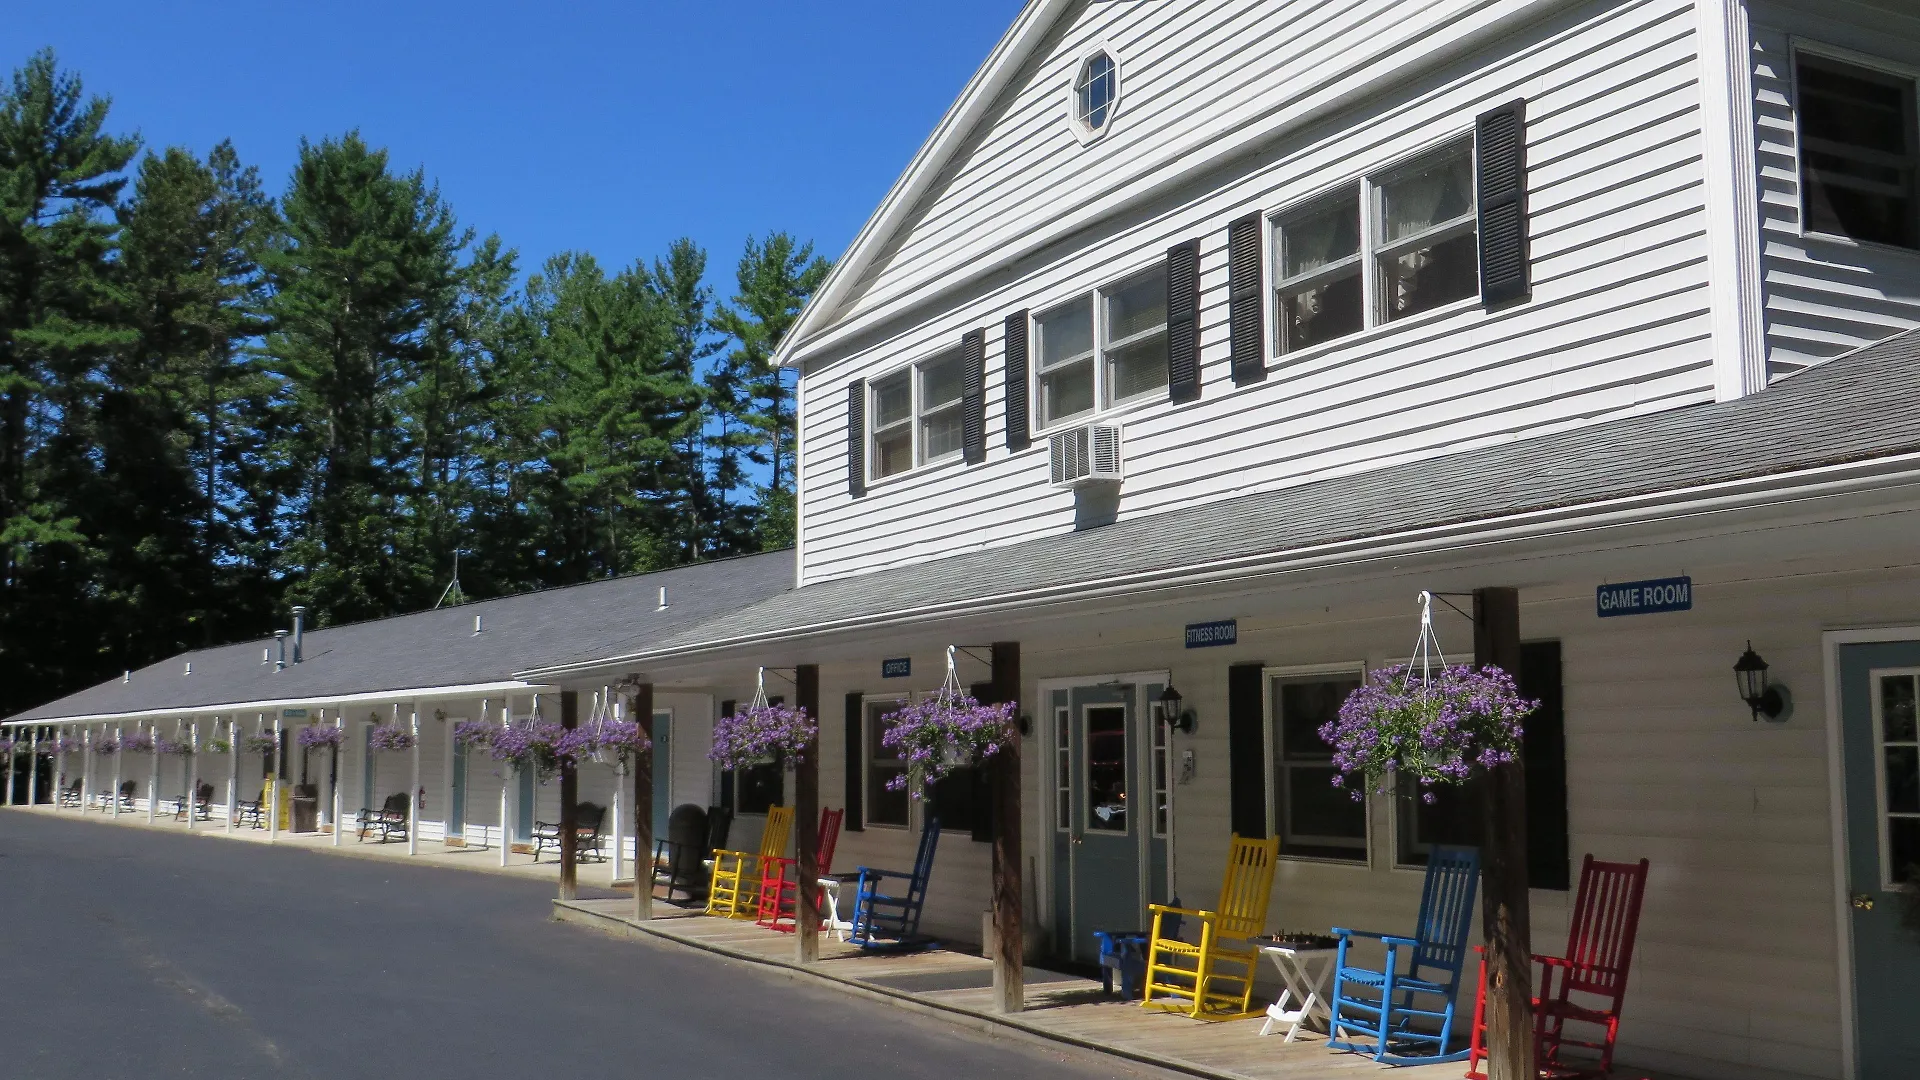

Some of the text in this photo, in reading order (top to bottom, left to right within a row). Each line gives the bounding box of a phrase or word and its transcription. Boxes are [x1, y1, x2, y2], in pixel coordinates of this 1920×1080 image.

[1600, 584, 1688, 610] GAME ROOM
[1187, 625, 1235, 643] FITNESS ROOM
[886, 662, 907, 674] OFFICE
